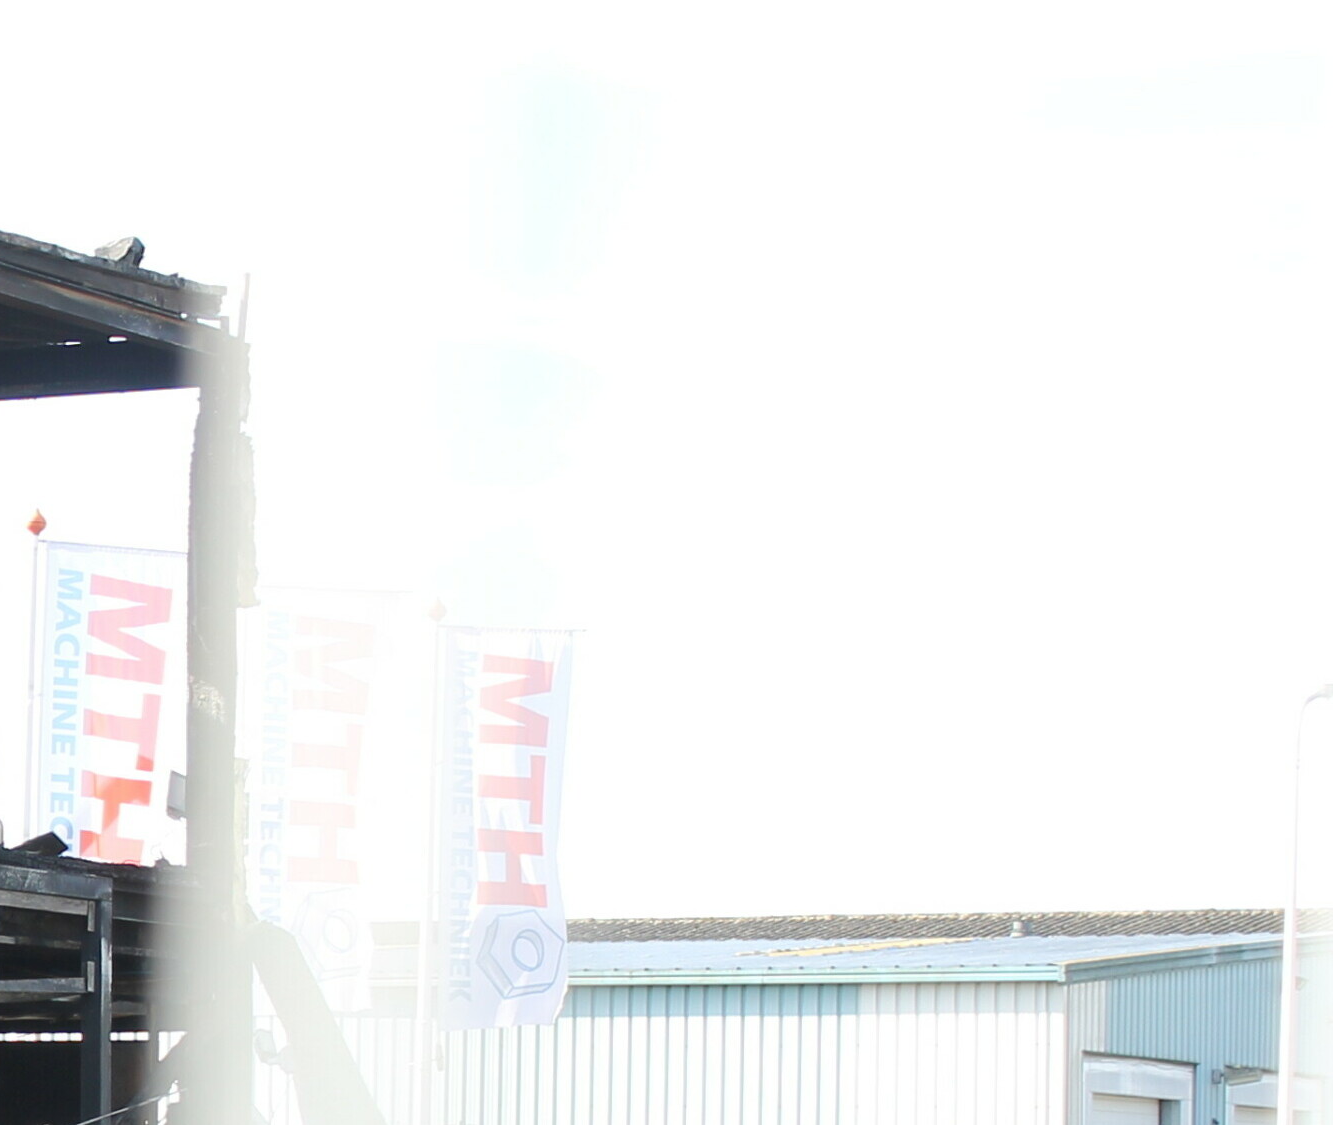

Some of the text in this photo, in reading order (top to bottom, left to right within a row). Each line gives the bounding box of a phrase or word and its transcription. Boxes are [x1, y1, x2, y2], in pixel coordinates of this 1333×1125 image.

[49, 567, 84, 856] MACHINE TEC
[79, 573, 173, 864] MTH
[261, 611, 290, 787] MACHINE
[288, 615, 375, 885] MTH
[448, 649, 479, 1004] MACHINE TECHNIEK
[476, 653, 555, 908] MTH
